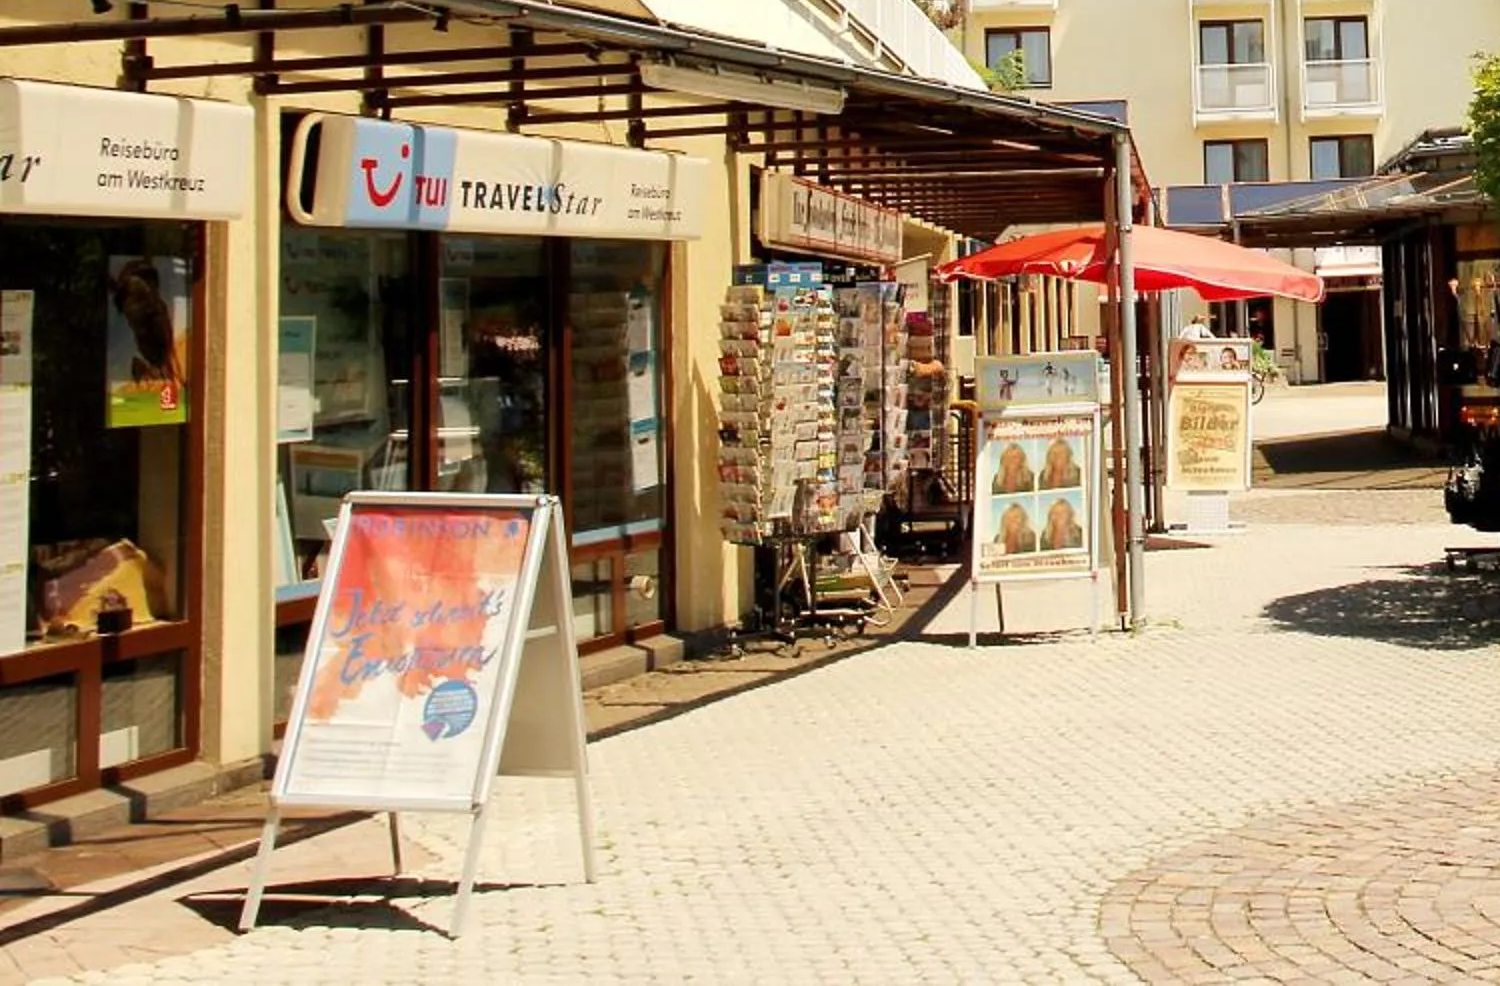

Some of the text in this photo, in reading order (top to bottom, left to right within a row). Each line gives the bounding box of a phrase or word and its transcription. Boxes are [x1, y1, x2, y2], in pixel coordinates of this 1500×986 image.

[100, 137, 179, 161] Reisebüro
[0, 153, 41, 183] ar
[97, 170, 205, 192] am Westkreuz
[415, 175, 447, 207] TUI
